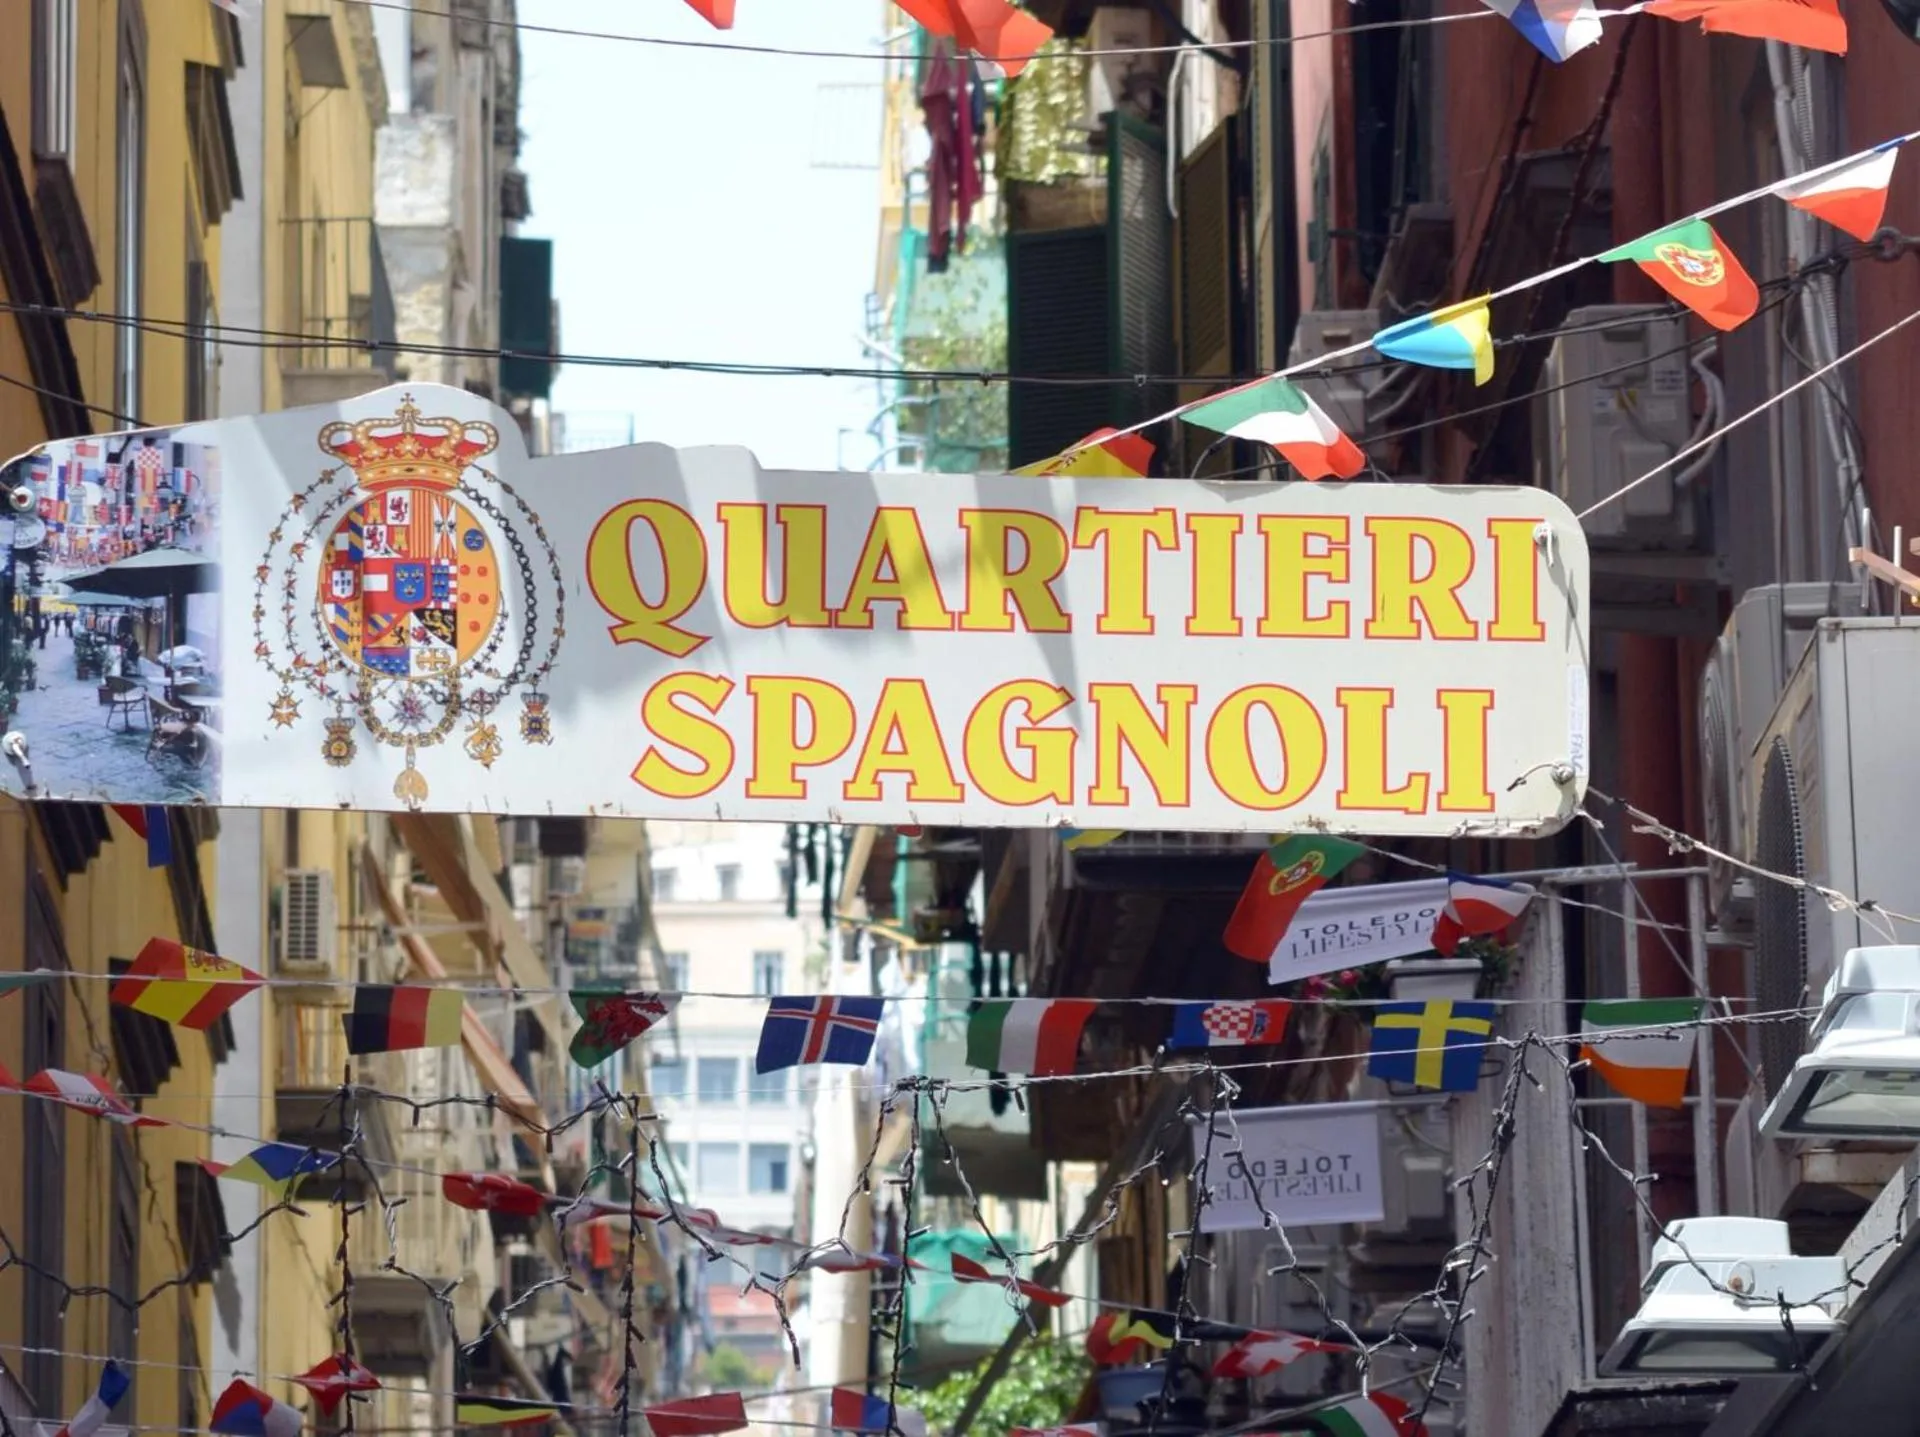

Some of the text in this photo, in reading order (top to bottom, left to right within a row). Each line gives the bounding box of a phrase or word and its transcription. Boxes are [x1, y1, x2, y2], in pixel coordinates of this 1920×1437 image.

[586, 498, 1546, 658] QUARTIERI
[630, 671, 1496, 815] SPAGNOLI
[1299, 907, 1437, 939] TOLEDO
